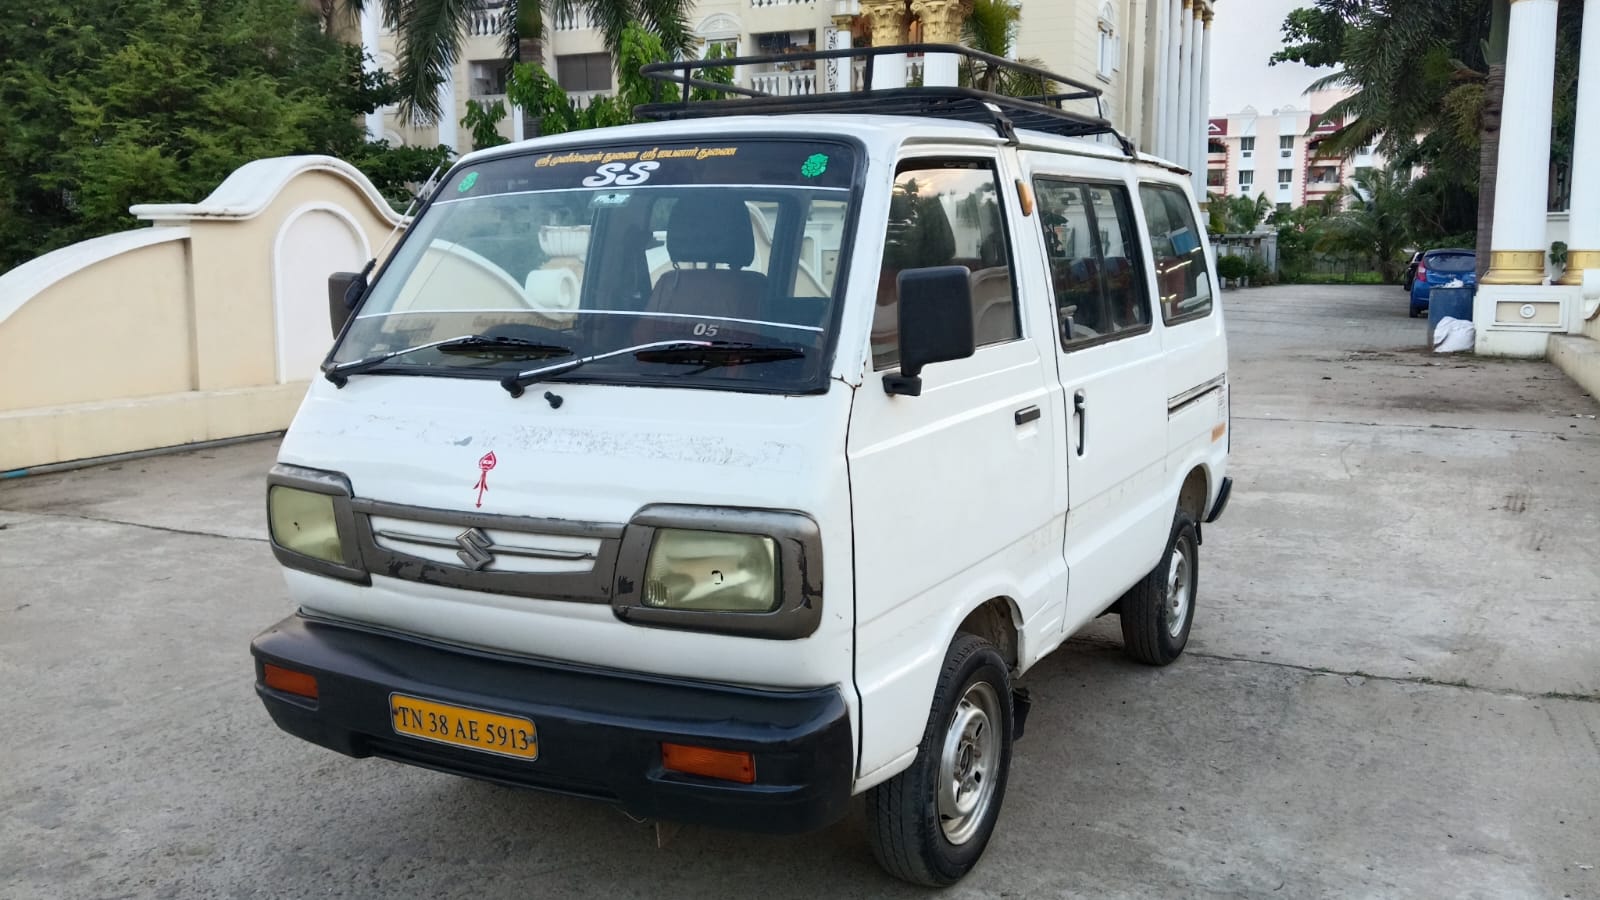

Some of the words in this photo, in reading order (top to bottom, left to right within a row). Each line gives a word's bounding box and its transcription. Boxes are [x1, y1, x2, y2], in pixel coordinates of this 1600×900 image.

[582, 161, 660, 187] SS
[693, 323, 719, 337] 05
[399, 706, 422, 729] TN
[429, 712, 448, 735] 38
[456, 718, 480, 742] AE
[487, 723, 529, 750] 5913
